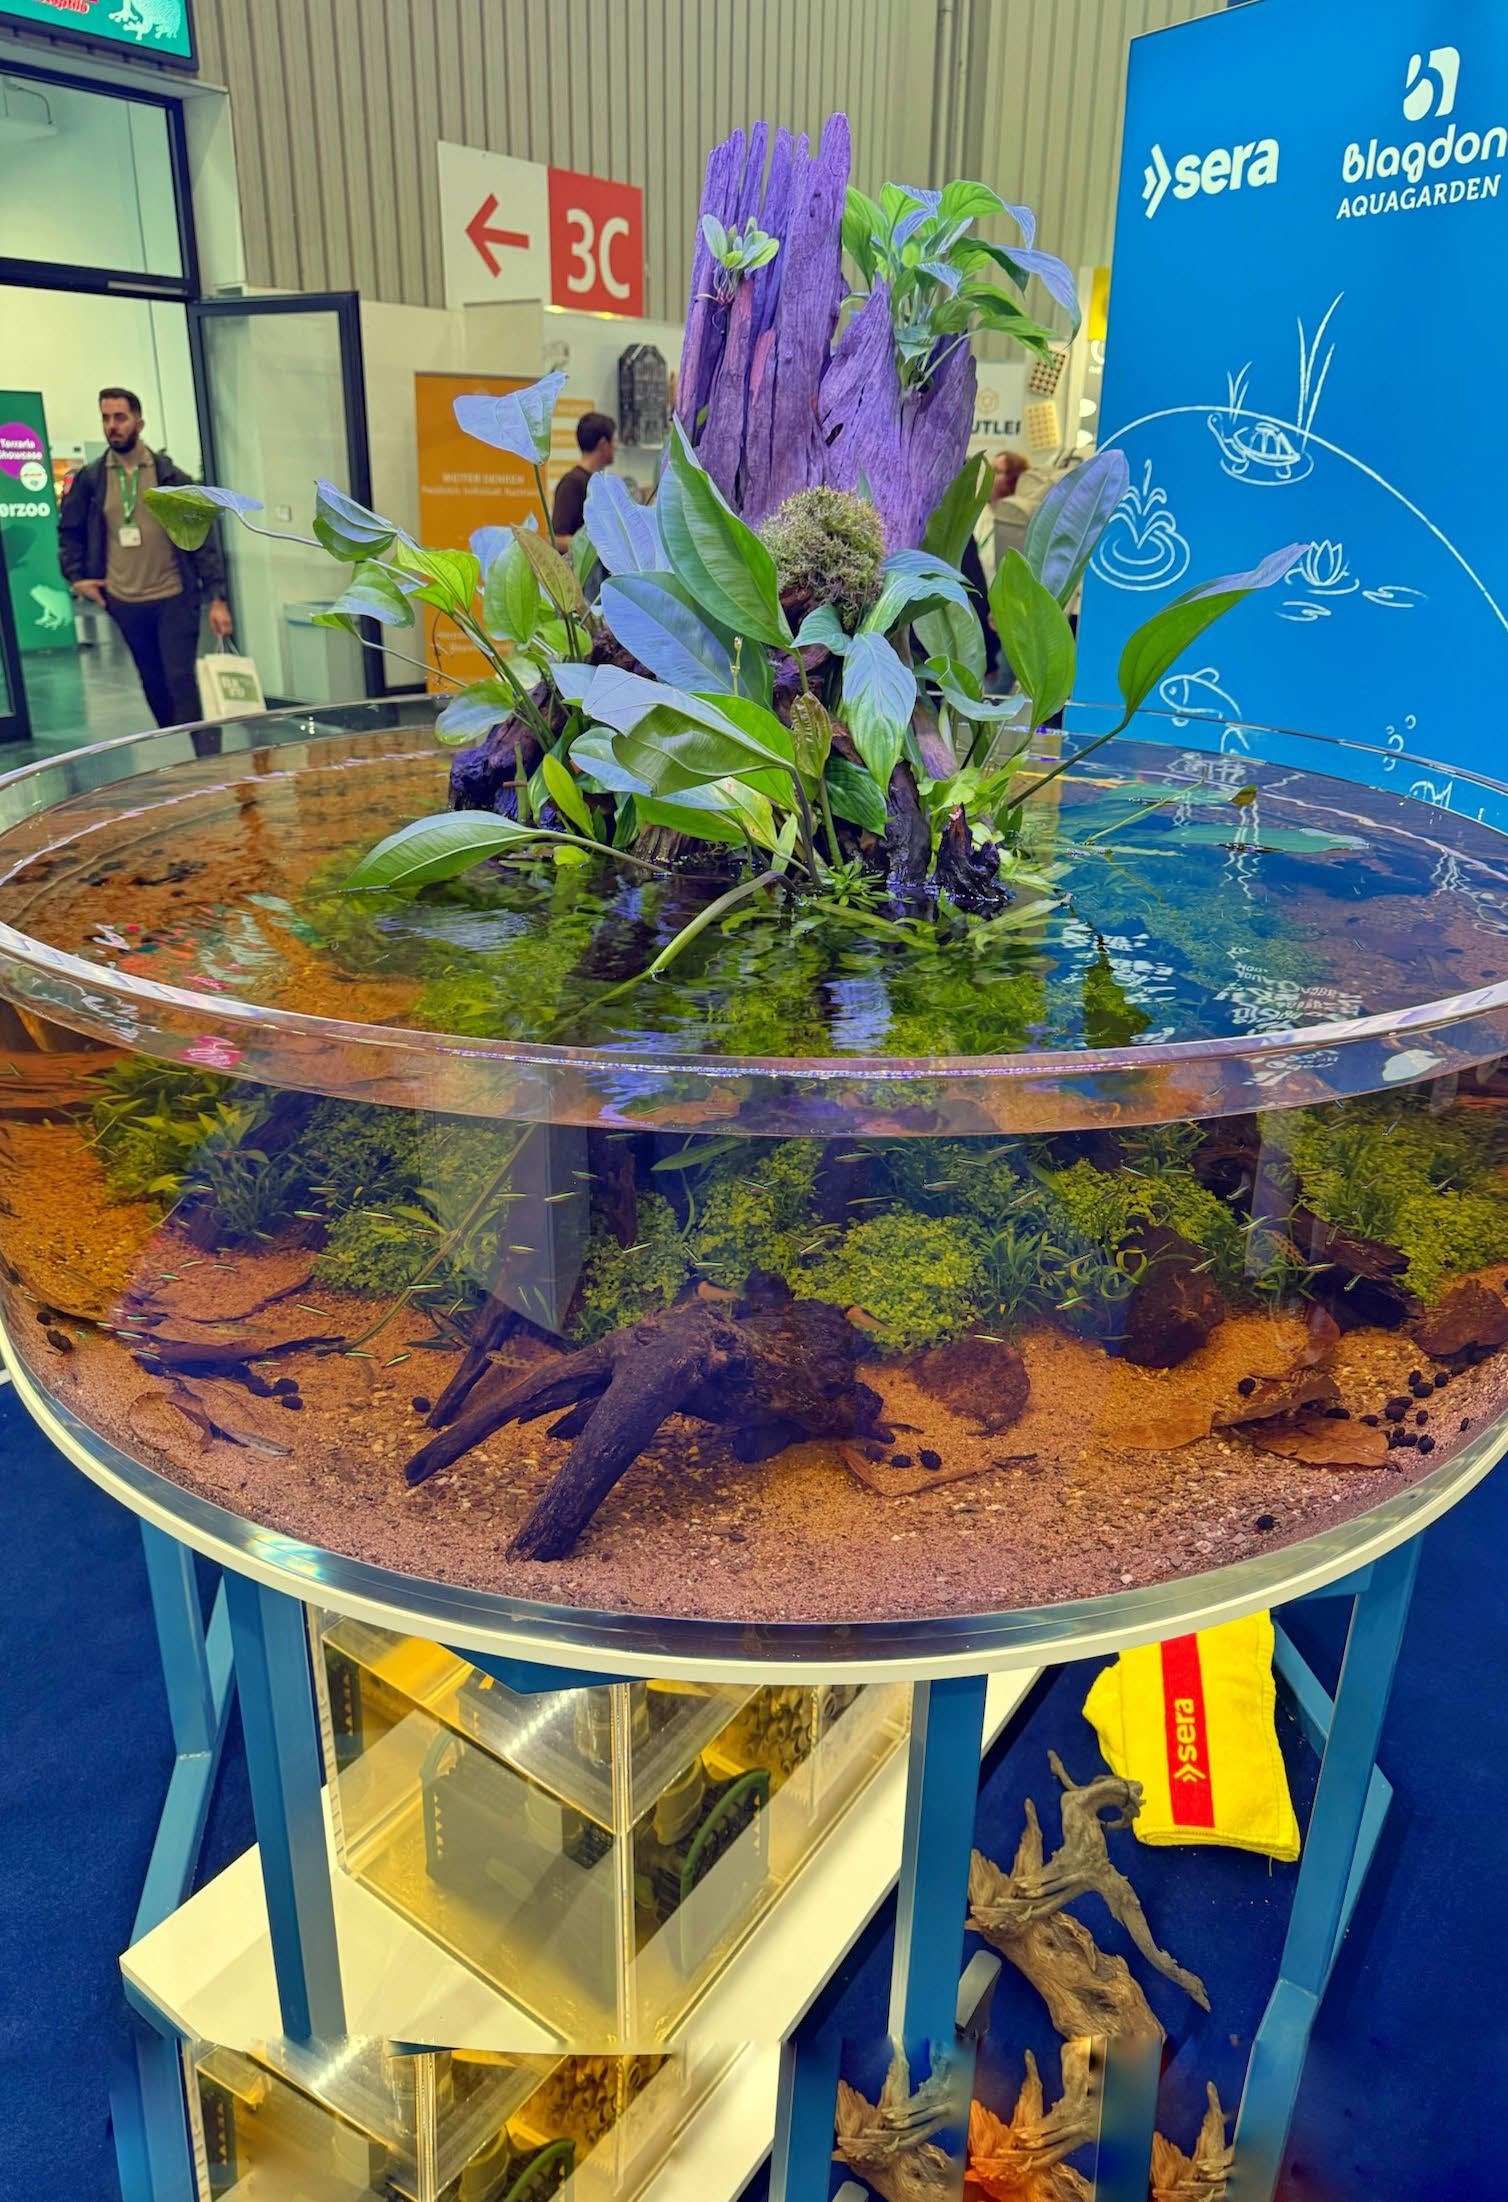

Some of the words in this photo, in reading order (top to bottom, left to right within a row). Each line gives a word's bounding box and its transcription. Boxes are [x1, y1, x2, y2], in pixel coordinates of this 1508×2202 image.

[1173, 138, 1280, 200] sera
[1342, 123, 1508, 184] blagdon
[1336, 174, 1501, 221] AQUAGARDEN
[566, 208, 631, 299] 3C
[1173, 1698, 1198, 1762] sera
